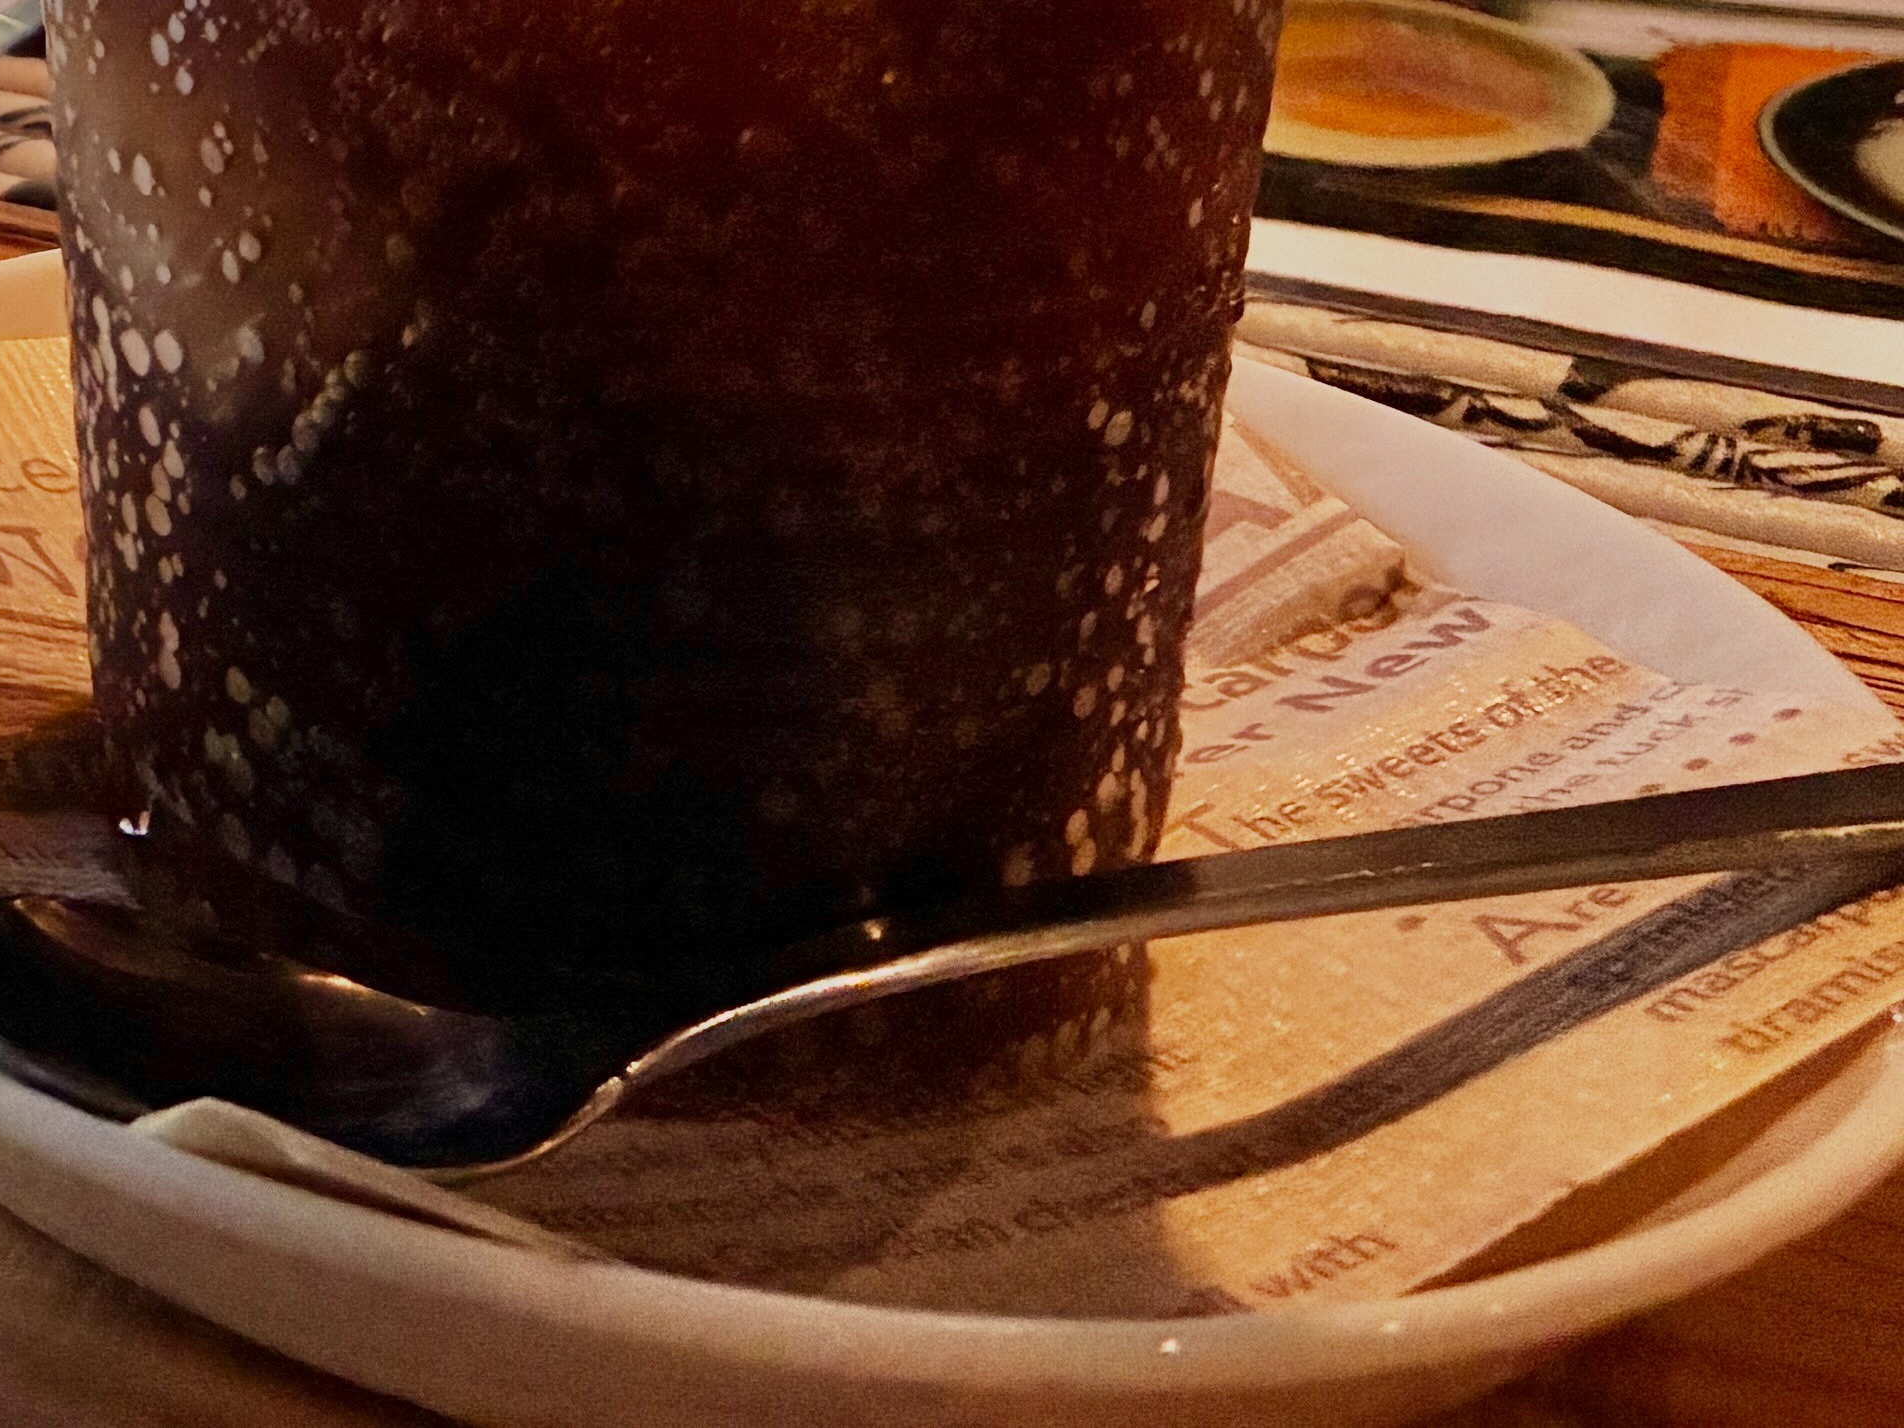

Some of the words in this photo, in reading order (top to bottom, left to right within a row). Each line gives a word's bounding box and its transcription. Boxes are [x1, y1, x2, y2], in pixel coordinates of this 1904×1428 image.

[1276, 604, 1493, 710] New
[1164, 799, 1306, 852] The
[1313, 714, 1483, 808] sweets
[1534, 651, 1629, 699] the
[1470, 881, 1634, 967] Are
